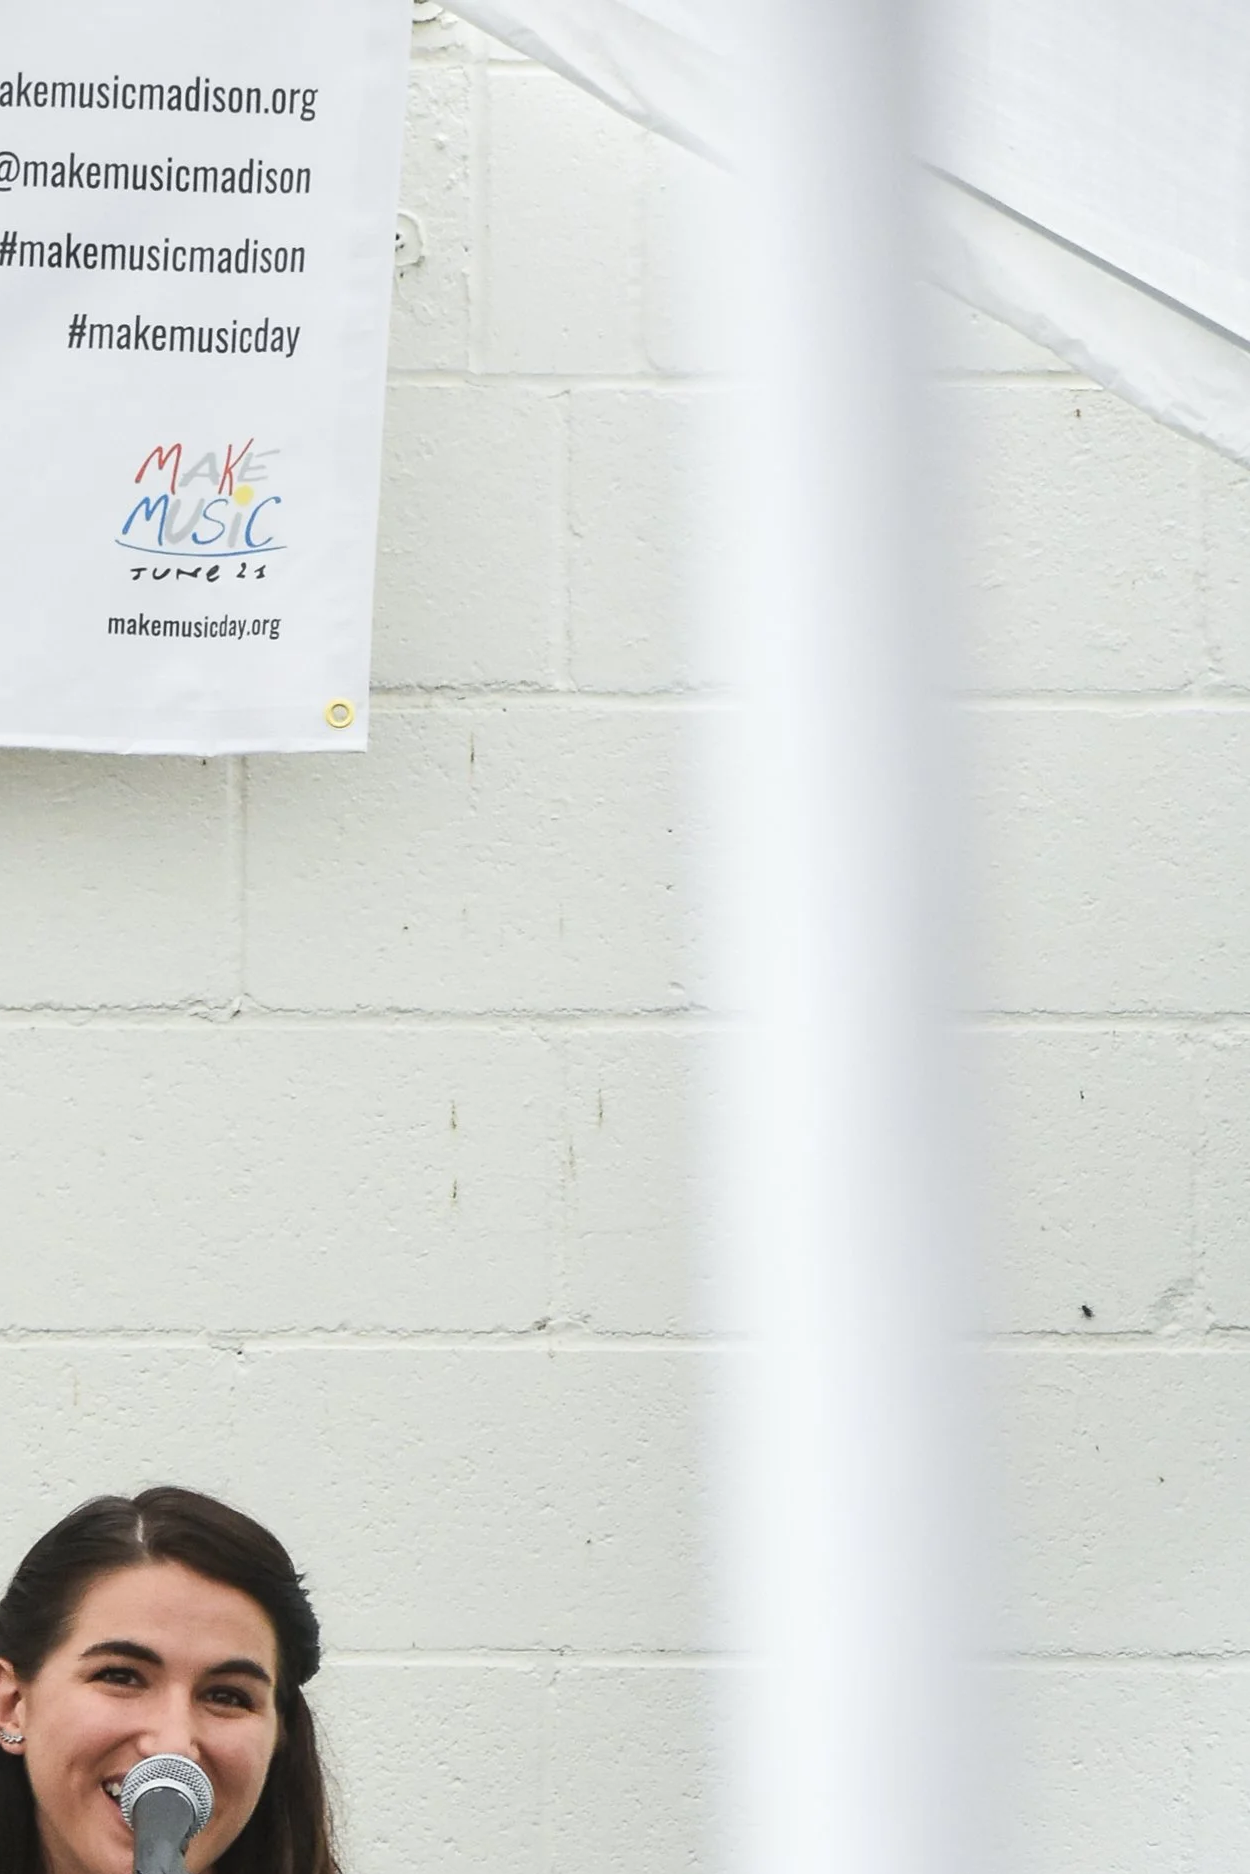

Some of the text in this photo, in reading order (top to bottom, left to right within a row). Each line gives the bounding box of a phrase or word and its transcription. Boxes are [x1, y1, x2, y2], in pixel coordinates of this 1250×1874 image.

[67, 314, 301, 358] #makemusicday
[134, 437, 281, 496] MAKE
[121, 492, 282, 549] MUSIC
[130, 561, 267, 583] JUNE 21
[107, 613, 282, 641] makemusicday.org
